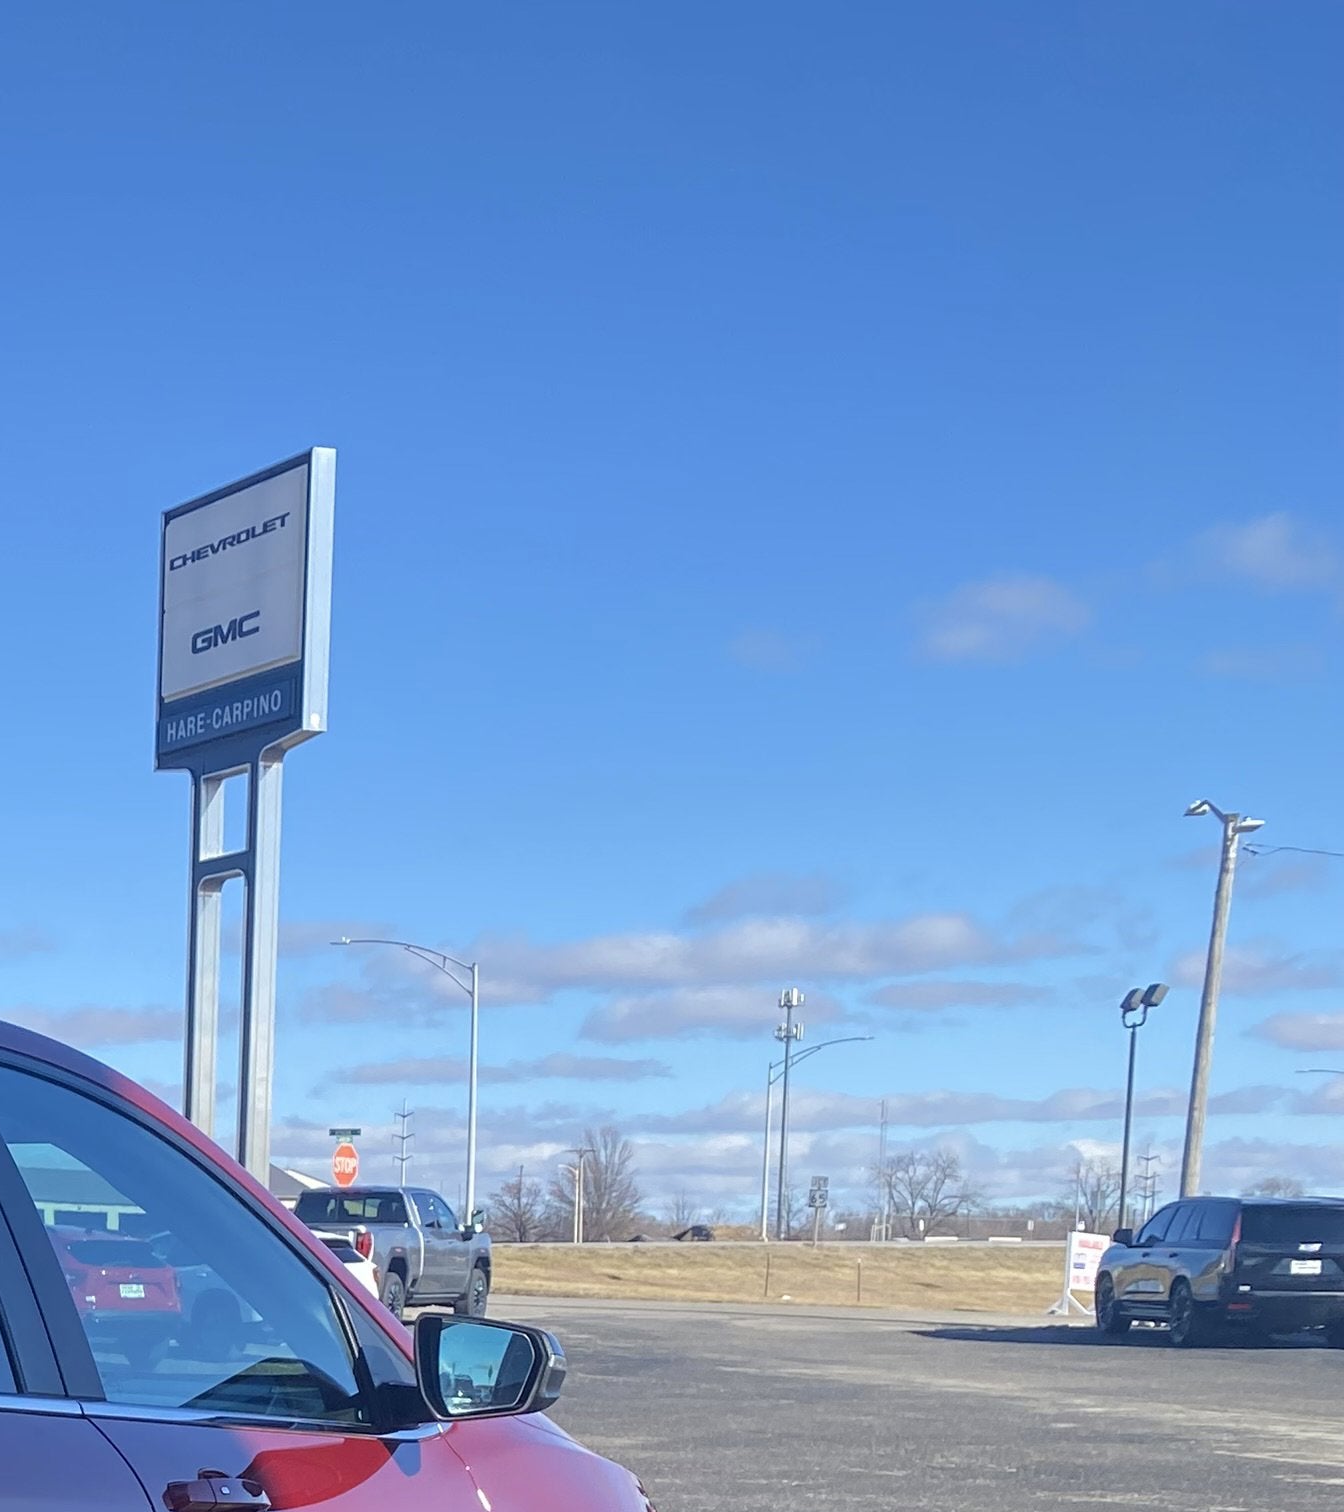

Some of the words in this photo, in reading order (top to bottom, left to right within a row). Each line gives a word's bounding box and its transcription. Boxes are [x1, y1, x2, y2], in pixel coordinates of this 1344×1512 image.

[169, 511, 291, 571] CHEVROLET
[191, 610, 261, 655] GMC
[167, 689, 282, 744] HARE-CARPINO
[334, 1156, 358, 1174] STOP
